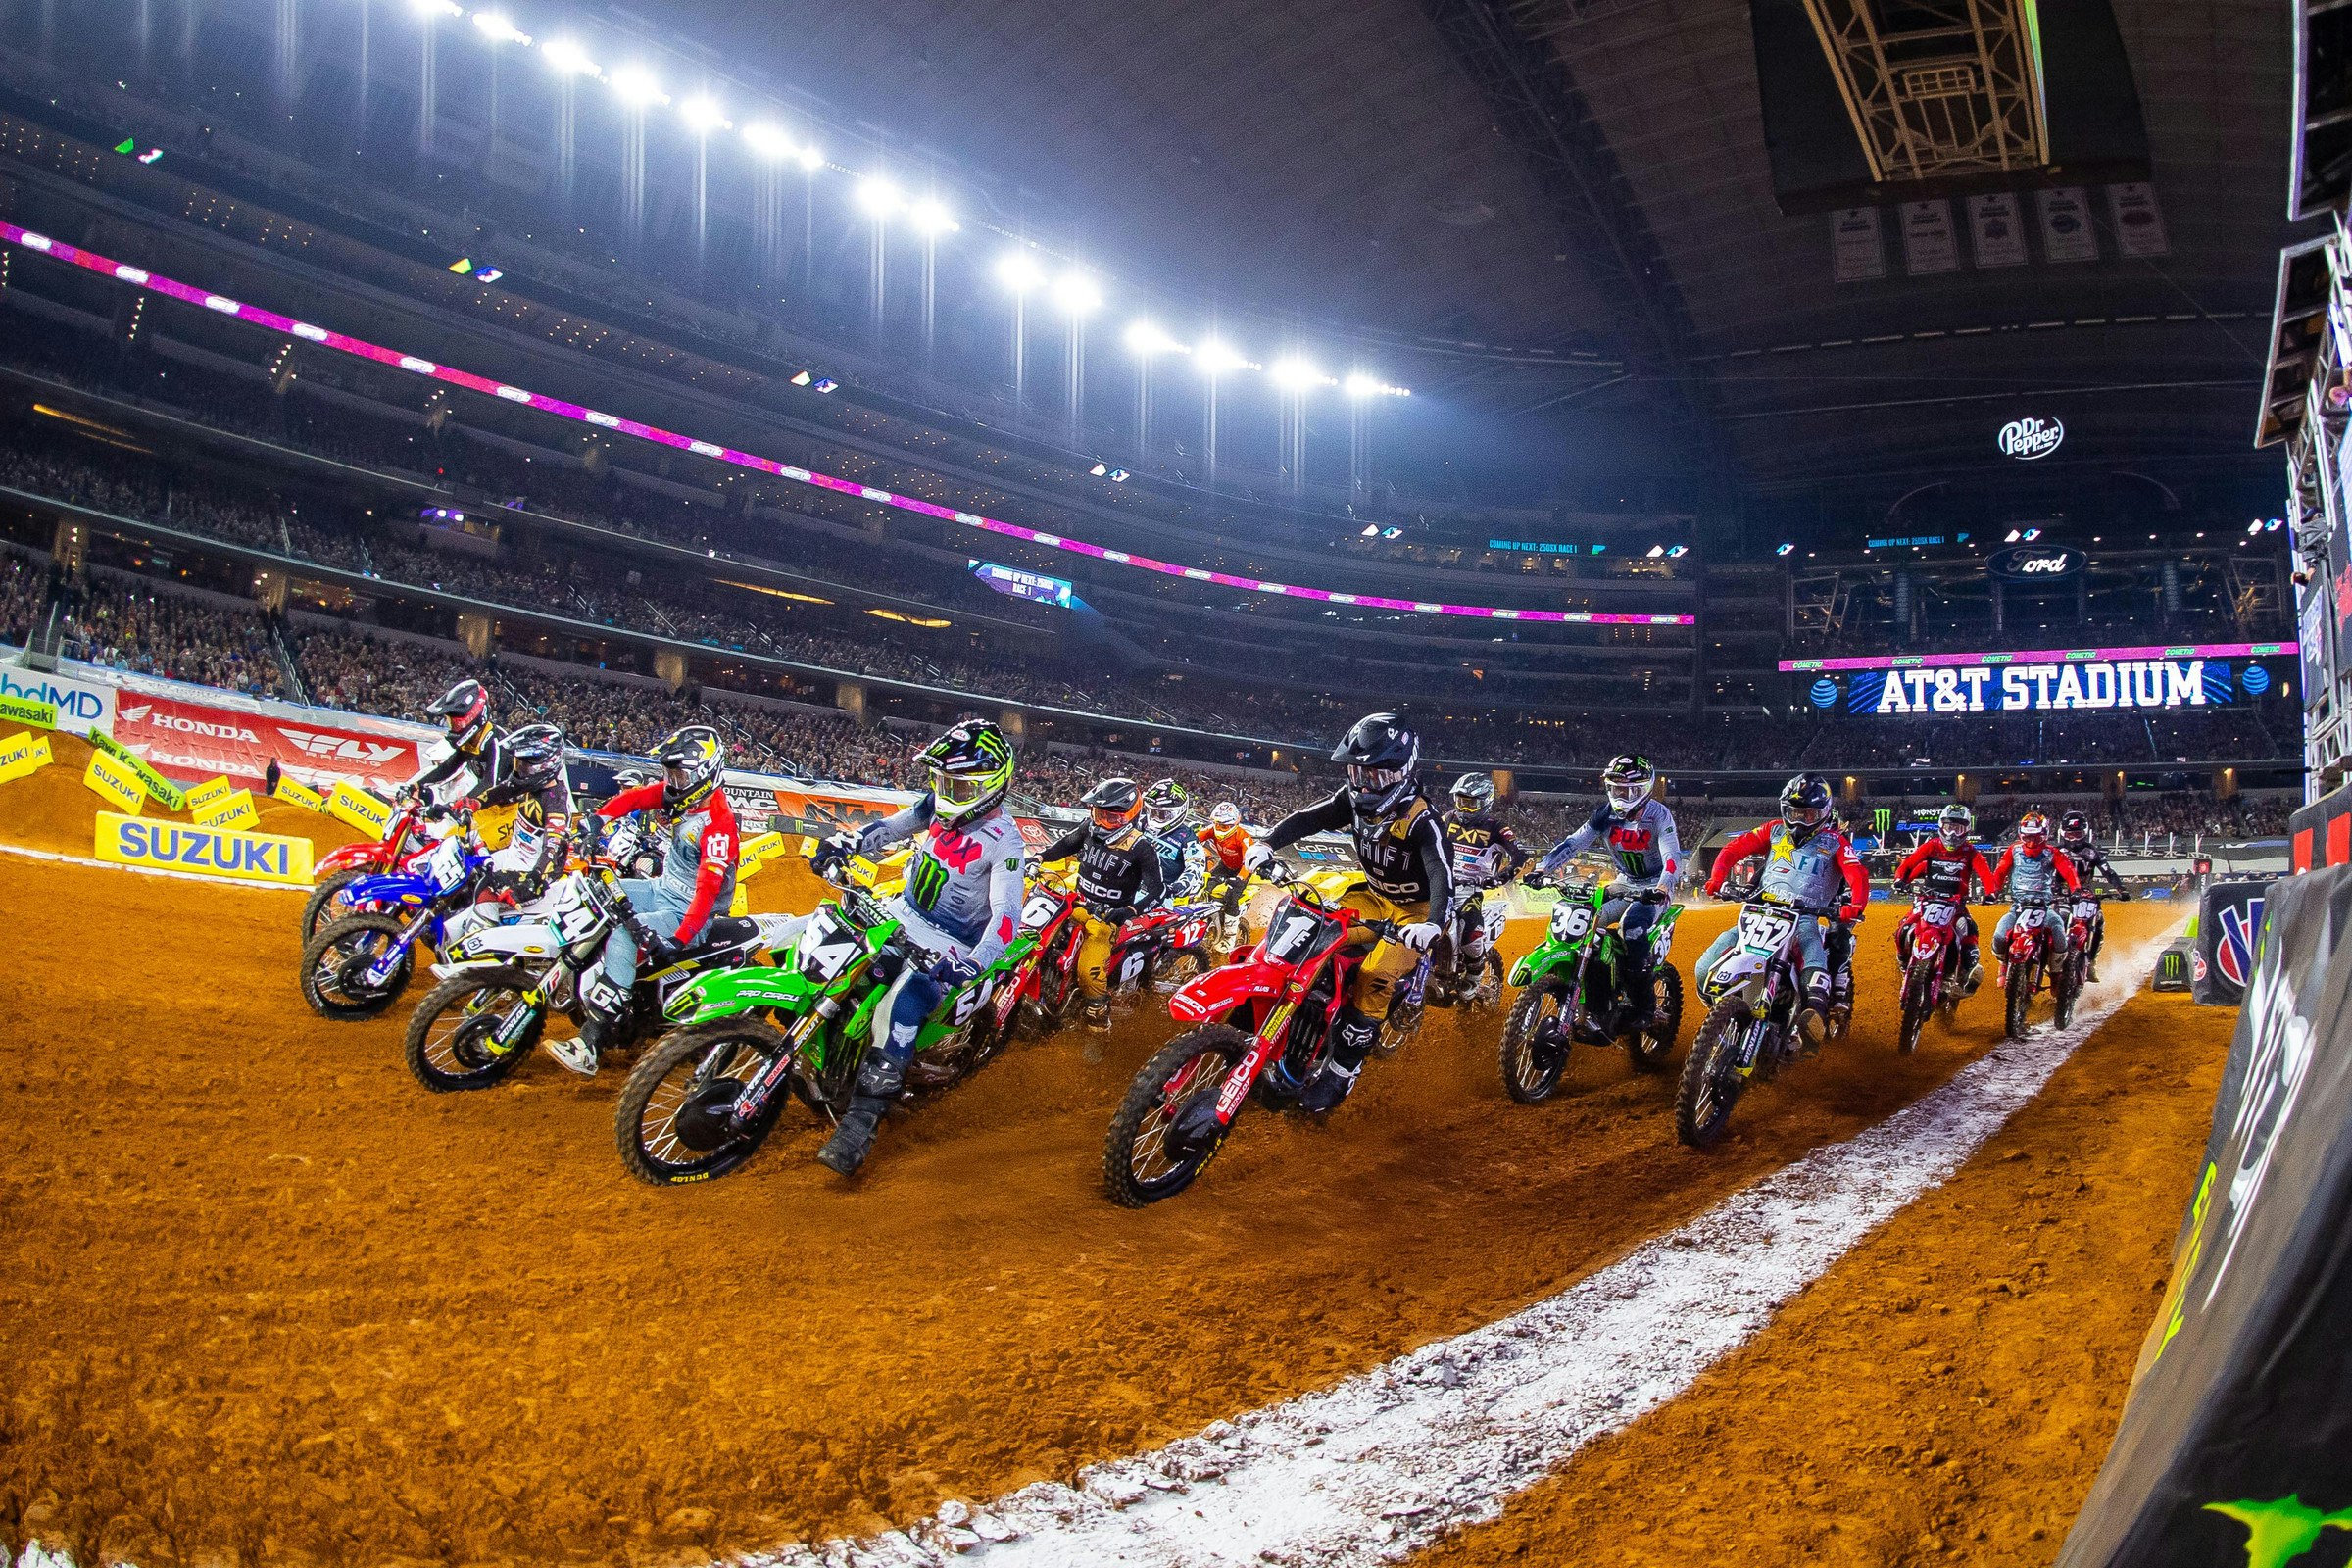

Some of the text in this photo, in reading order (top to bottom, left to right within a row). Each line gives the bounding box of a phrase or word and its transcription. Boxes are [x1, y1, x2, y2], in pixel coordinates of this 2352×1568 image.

[2021, 417, 2044, 437] Dr
[1489, 540, 1511, 549] COMING
[1512, 541, 1520, 550] UP
[1521, 542, 1539, 552] NEXT:
[1558, 545, 1573, 554] RACE
[2007, 550, 2067, 572] Ford
[1877, 661, 2206, 713] AT&T STADIUM
[0, 703, 54, 724] awasaki
[152, 712, 261, 744] HONDA
[277, 728, 406, 762] FLY
[306, 751, 382, 767] RACING
[93, 763, 140, 804] SUZUKI
[191, 785, 228, 807] SUZUKI
[723, 786, 774, 800] OUNTAIN
[281, 785, 319, 810] SUZUKI
[1447, 821, 1492, 847] FXR
[119, 821, 289, 876] SUZUKI
[1081, 842, 1132, 877] SHIFT
[1293, 841, 1346, 855] GoPro
[1020, 896, 1058, 928] 6
[1551, 906, 1592, 937] 36
[1923, 903, 1956, 926] 159
[2016, 907, 2046, 928] 43
[2071, 900, 2097, 919] 185
[1182, 922, 1201, 946] 12
[1742, 912, 1790, 951] 352
[1120, 951, 1145, 982] 6
[736, 989, 760, 998] PRO
[1175, 993, 1207, 1015] GEICO
[1173, 1002, 1196, 1017] HONDA
[793, 1017, 820, 1051] CIRCUIT
[1742, 1020, 1762, 1065] DUNLOP
[764, 1054, 791, 1087] BRAKING
[1216, 1050, 1260, 1113] GEICO
[733, 1058, 773, 1110] DUNLOP
[1227, 1076, 1251, 1116] DUNLOP
[670, 1172, 710, 1183] DUNLOP
